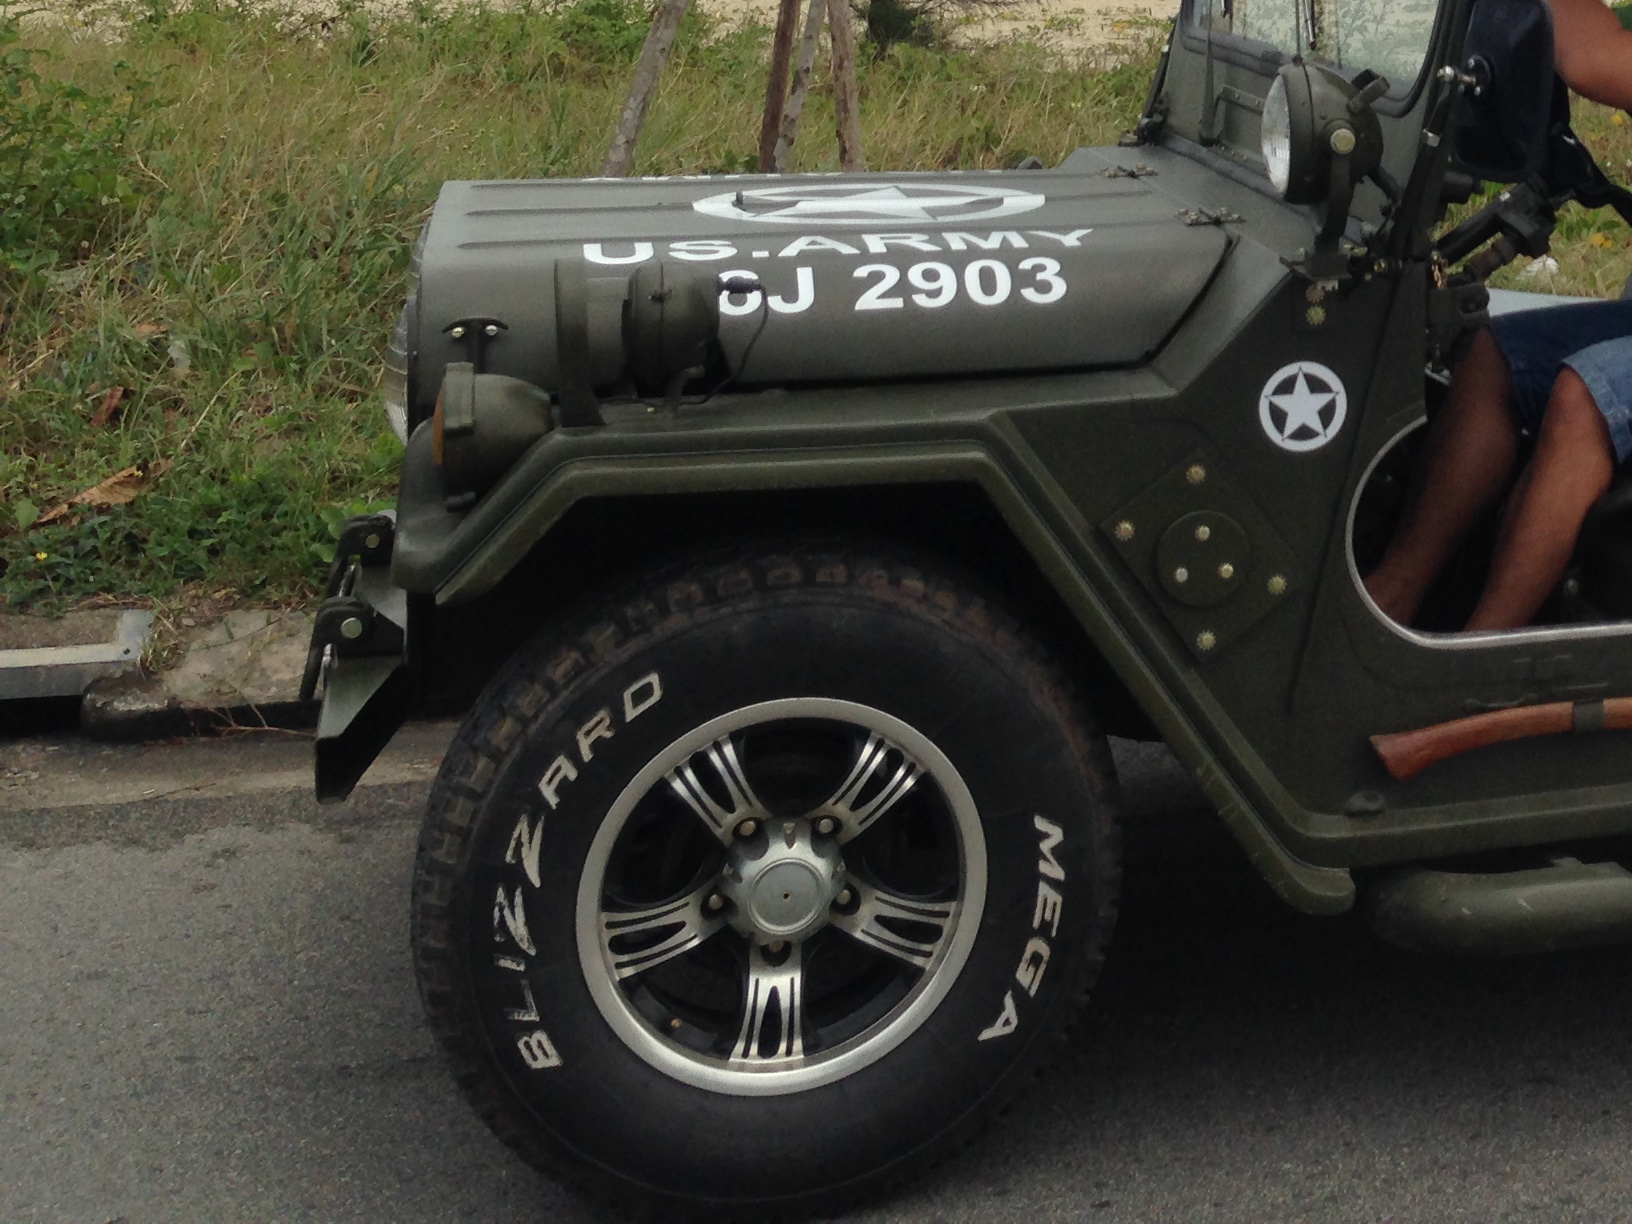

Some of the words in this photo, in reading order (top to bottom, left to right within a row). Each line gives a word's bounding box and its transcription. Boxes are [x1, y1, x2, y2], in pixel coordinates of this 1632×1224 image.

[852, 256, 1068, 312] 2903
[493, 671, 664, 1070] BLIZZARD
[977, 814, 1066, 1042] MEGA
